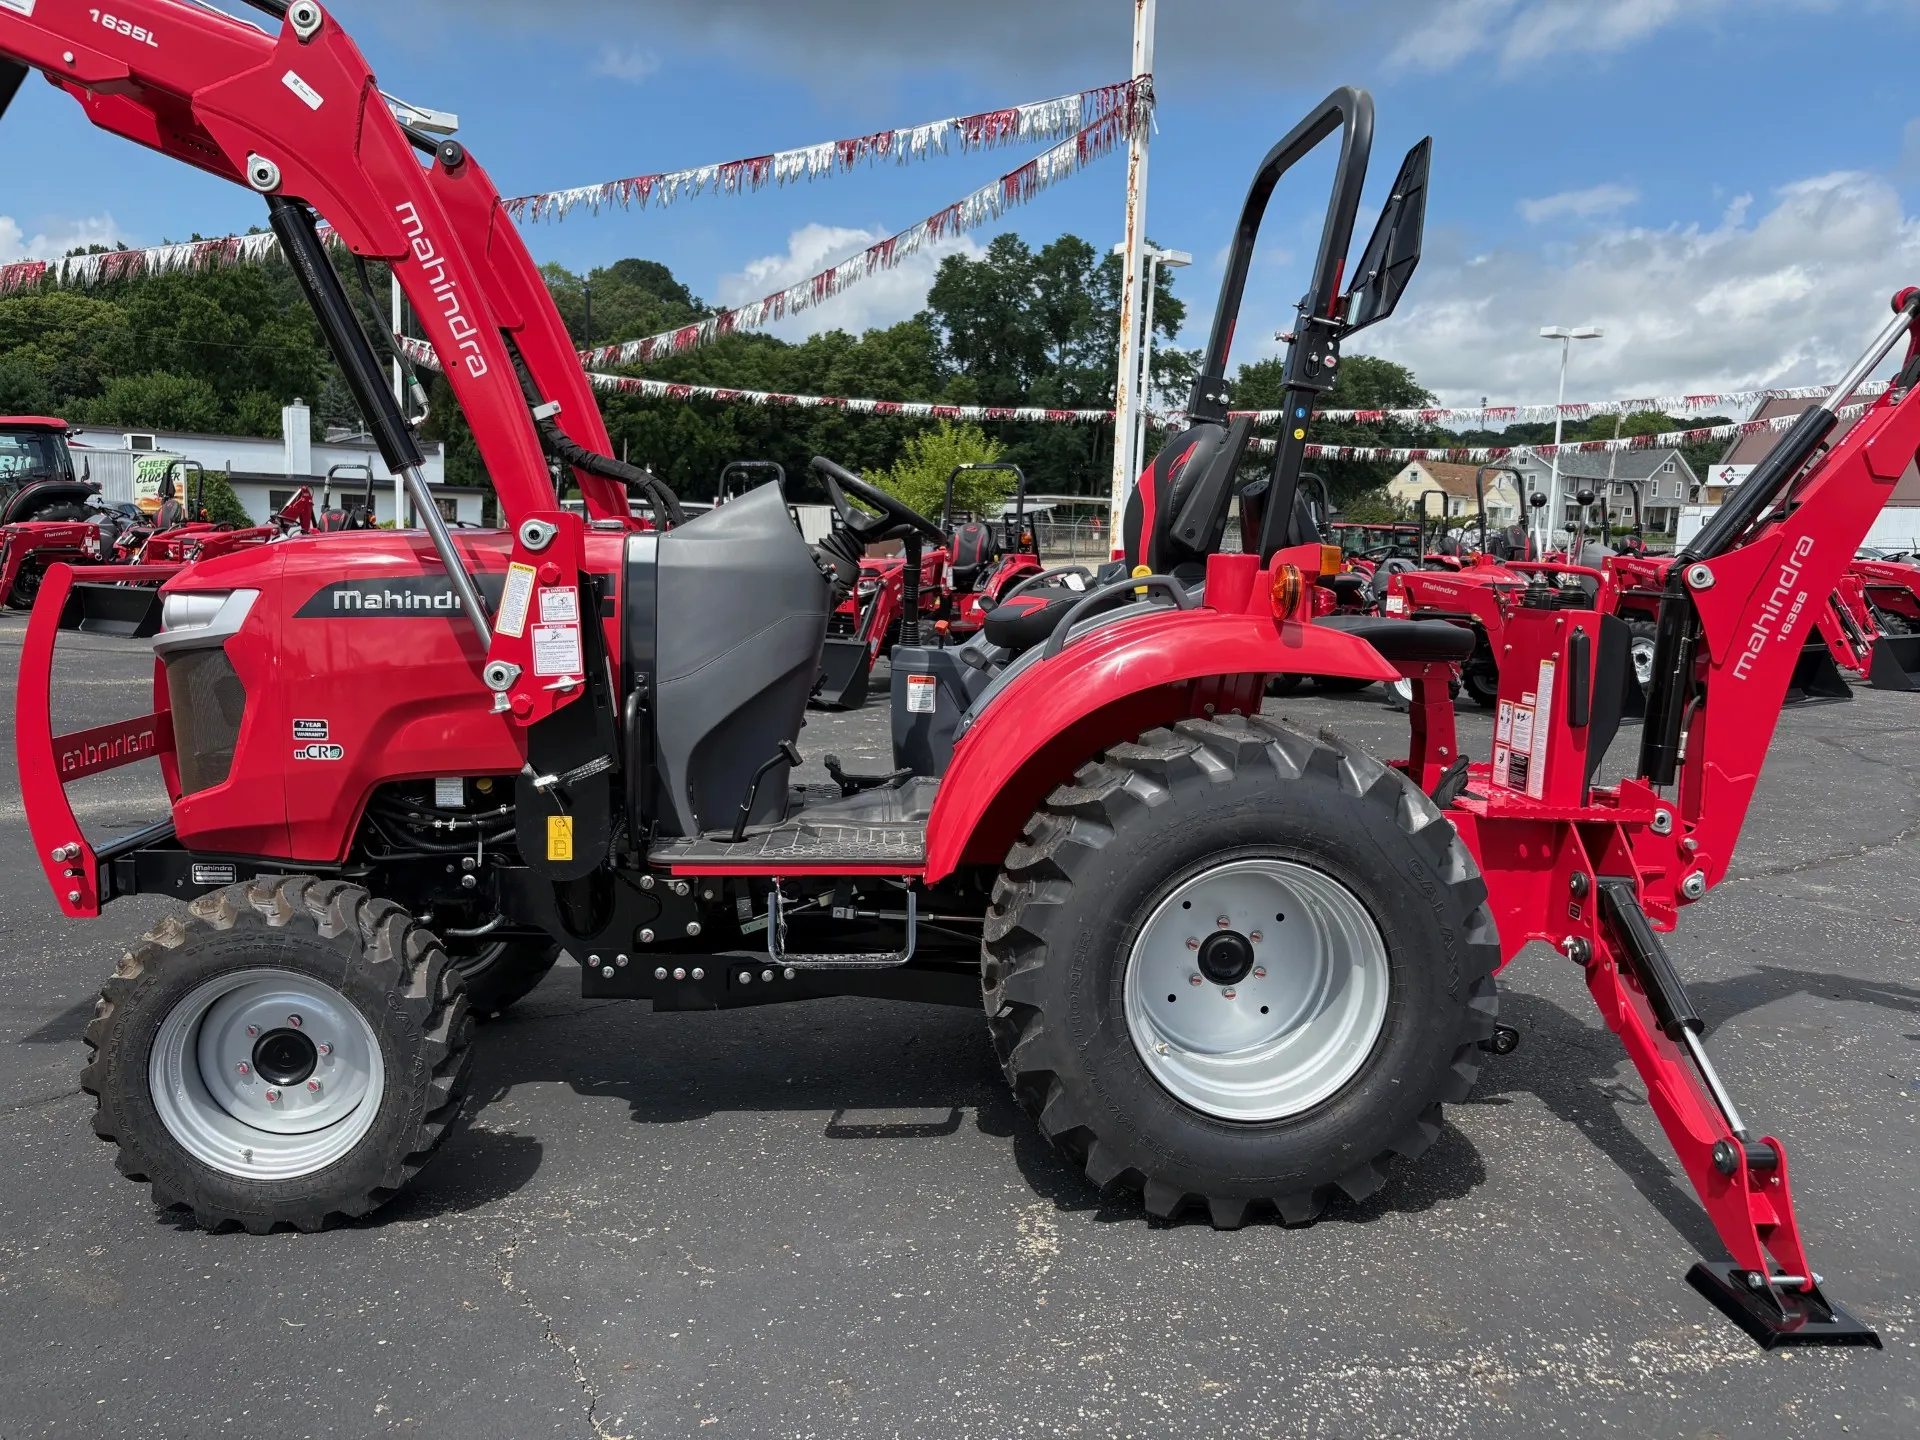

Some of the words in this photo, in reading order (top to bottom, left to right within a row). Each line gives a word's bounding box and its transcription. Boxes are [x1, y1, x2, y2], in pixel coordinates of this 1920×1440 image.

[89, 9, 158, 47] 1635L
[395, 201, 488, 378] mahindra
[136, 472, 181, 484] CLUCR
[1627, 563, 1656, 576] Mahind
[333, 590, 486, 609] Mahindr
[1732, 535, 1815, 681] mahindra
[1777, 591, 1808, 642] 1635B
